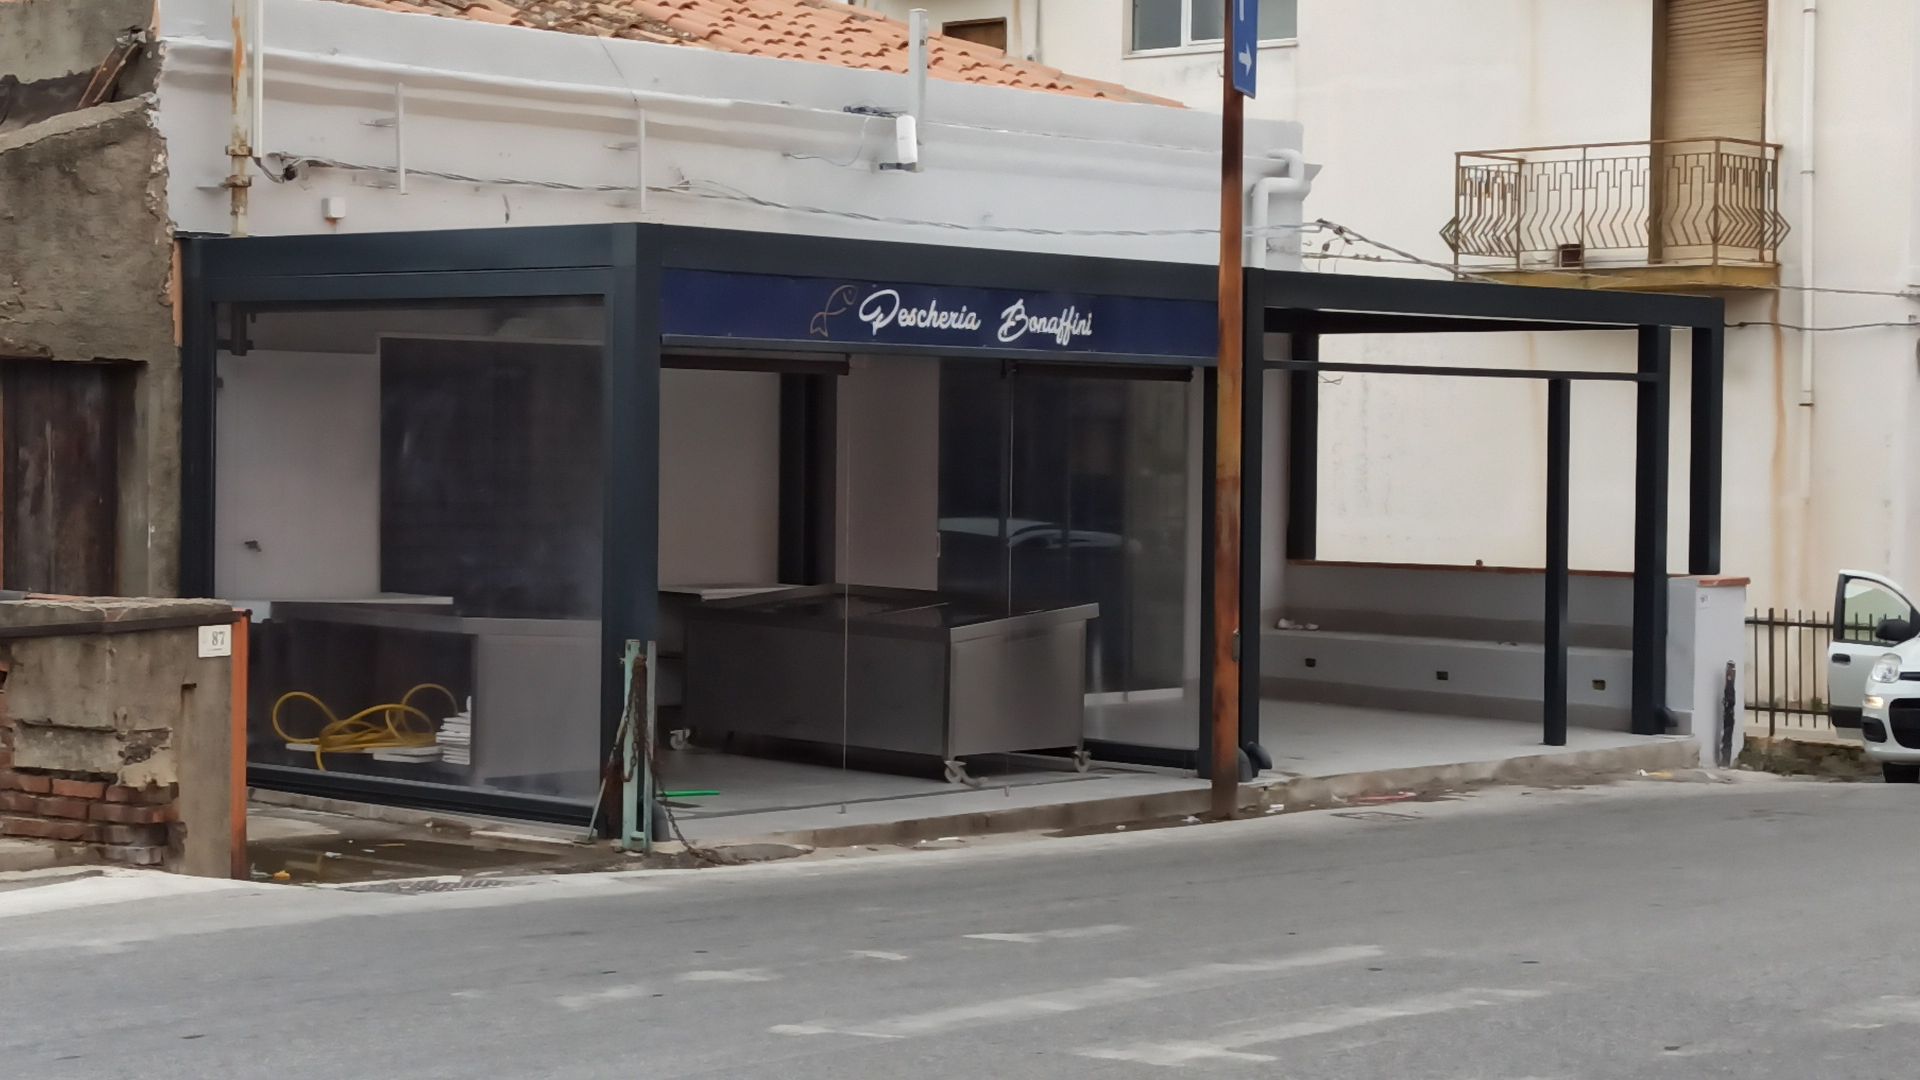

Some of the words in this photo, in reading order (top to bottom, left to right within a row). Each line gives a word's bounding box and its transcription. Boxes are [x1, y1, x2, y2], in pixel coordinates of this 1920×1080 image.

[858, 289, 981, 336] Pescheria
[997, 298, 1092, 346] Bonaffini
[211, 631, 225, 646] 87
